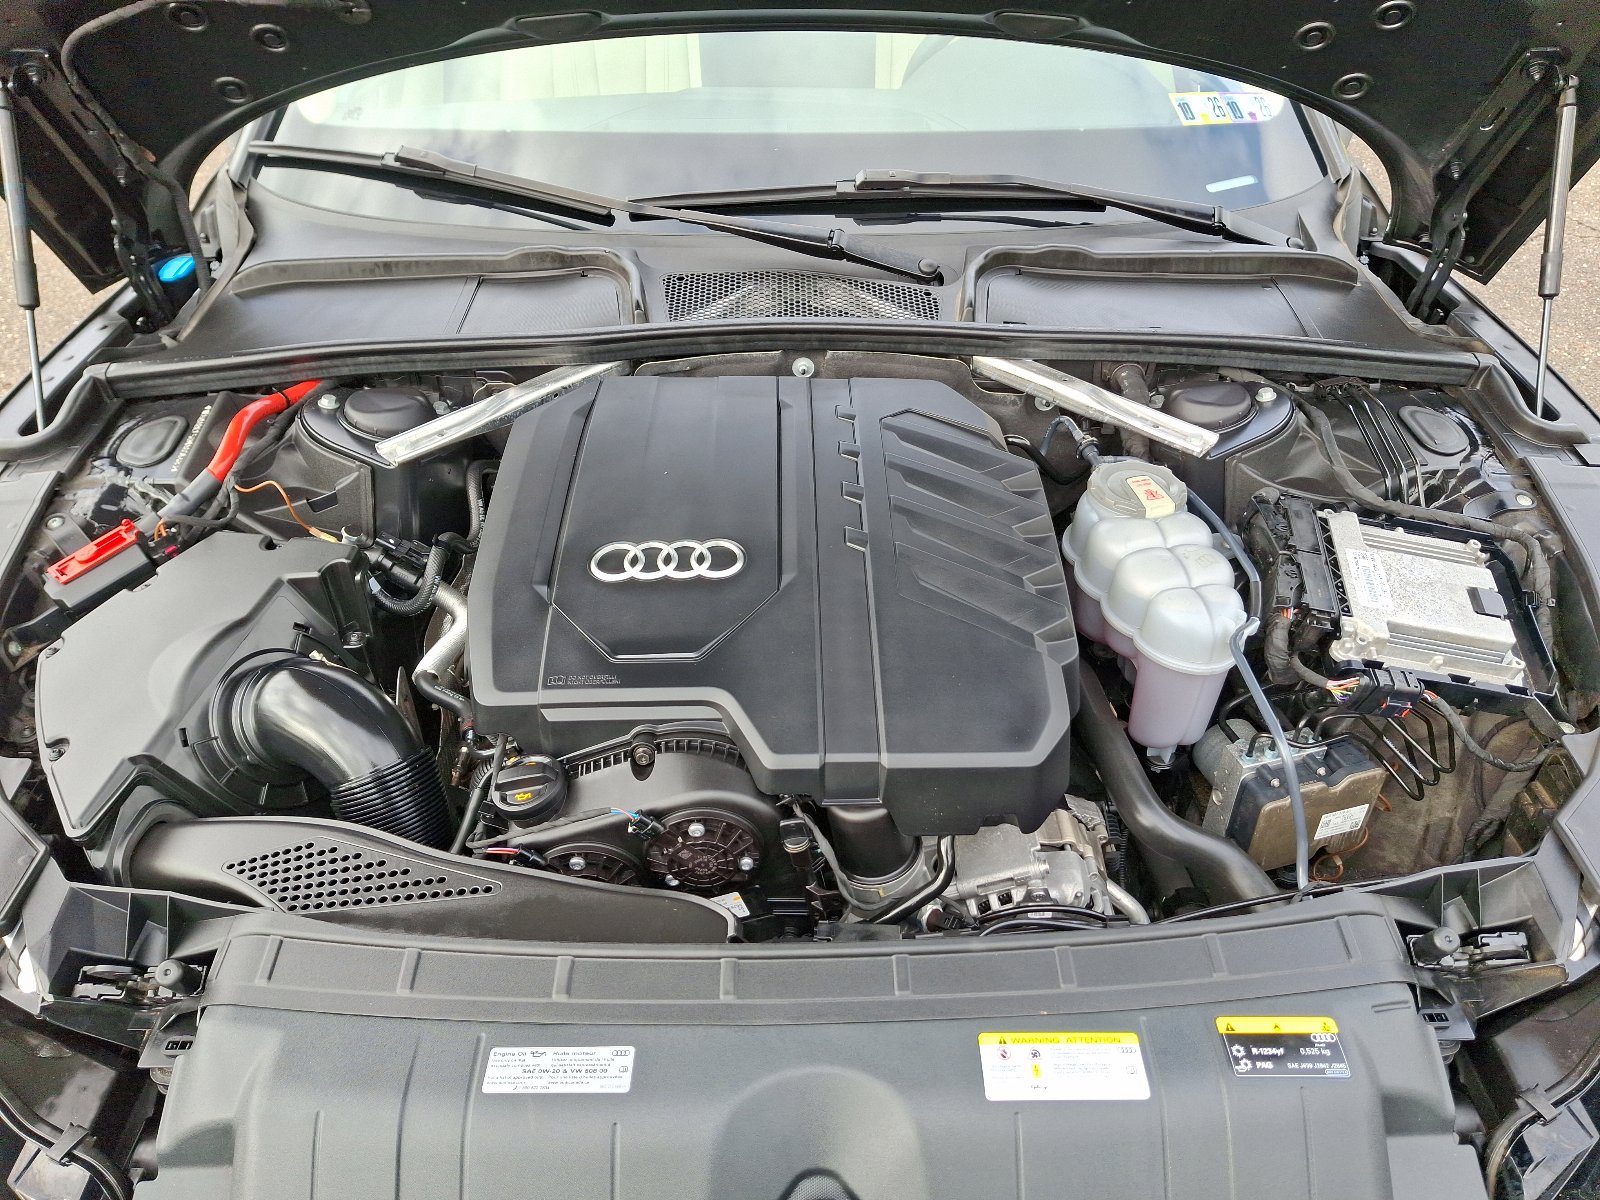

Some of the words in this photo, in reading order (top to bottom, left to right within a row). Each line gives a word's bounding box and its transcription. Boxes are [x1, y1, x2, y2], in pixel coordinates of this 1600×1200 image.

[1177, 102, 1196, 121] 10
[1207, 96, 1226, 118] 26
[1226, 101, 1244, 120] 10
[1320, 1047, 1331, 1056] kg
[1255, 1061, 1274, 1069] PAG
